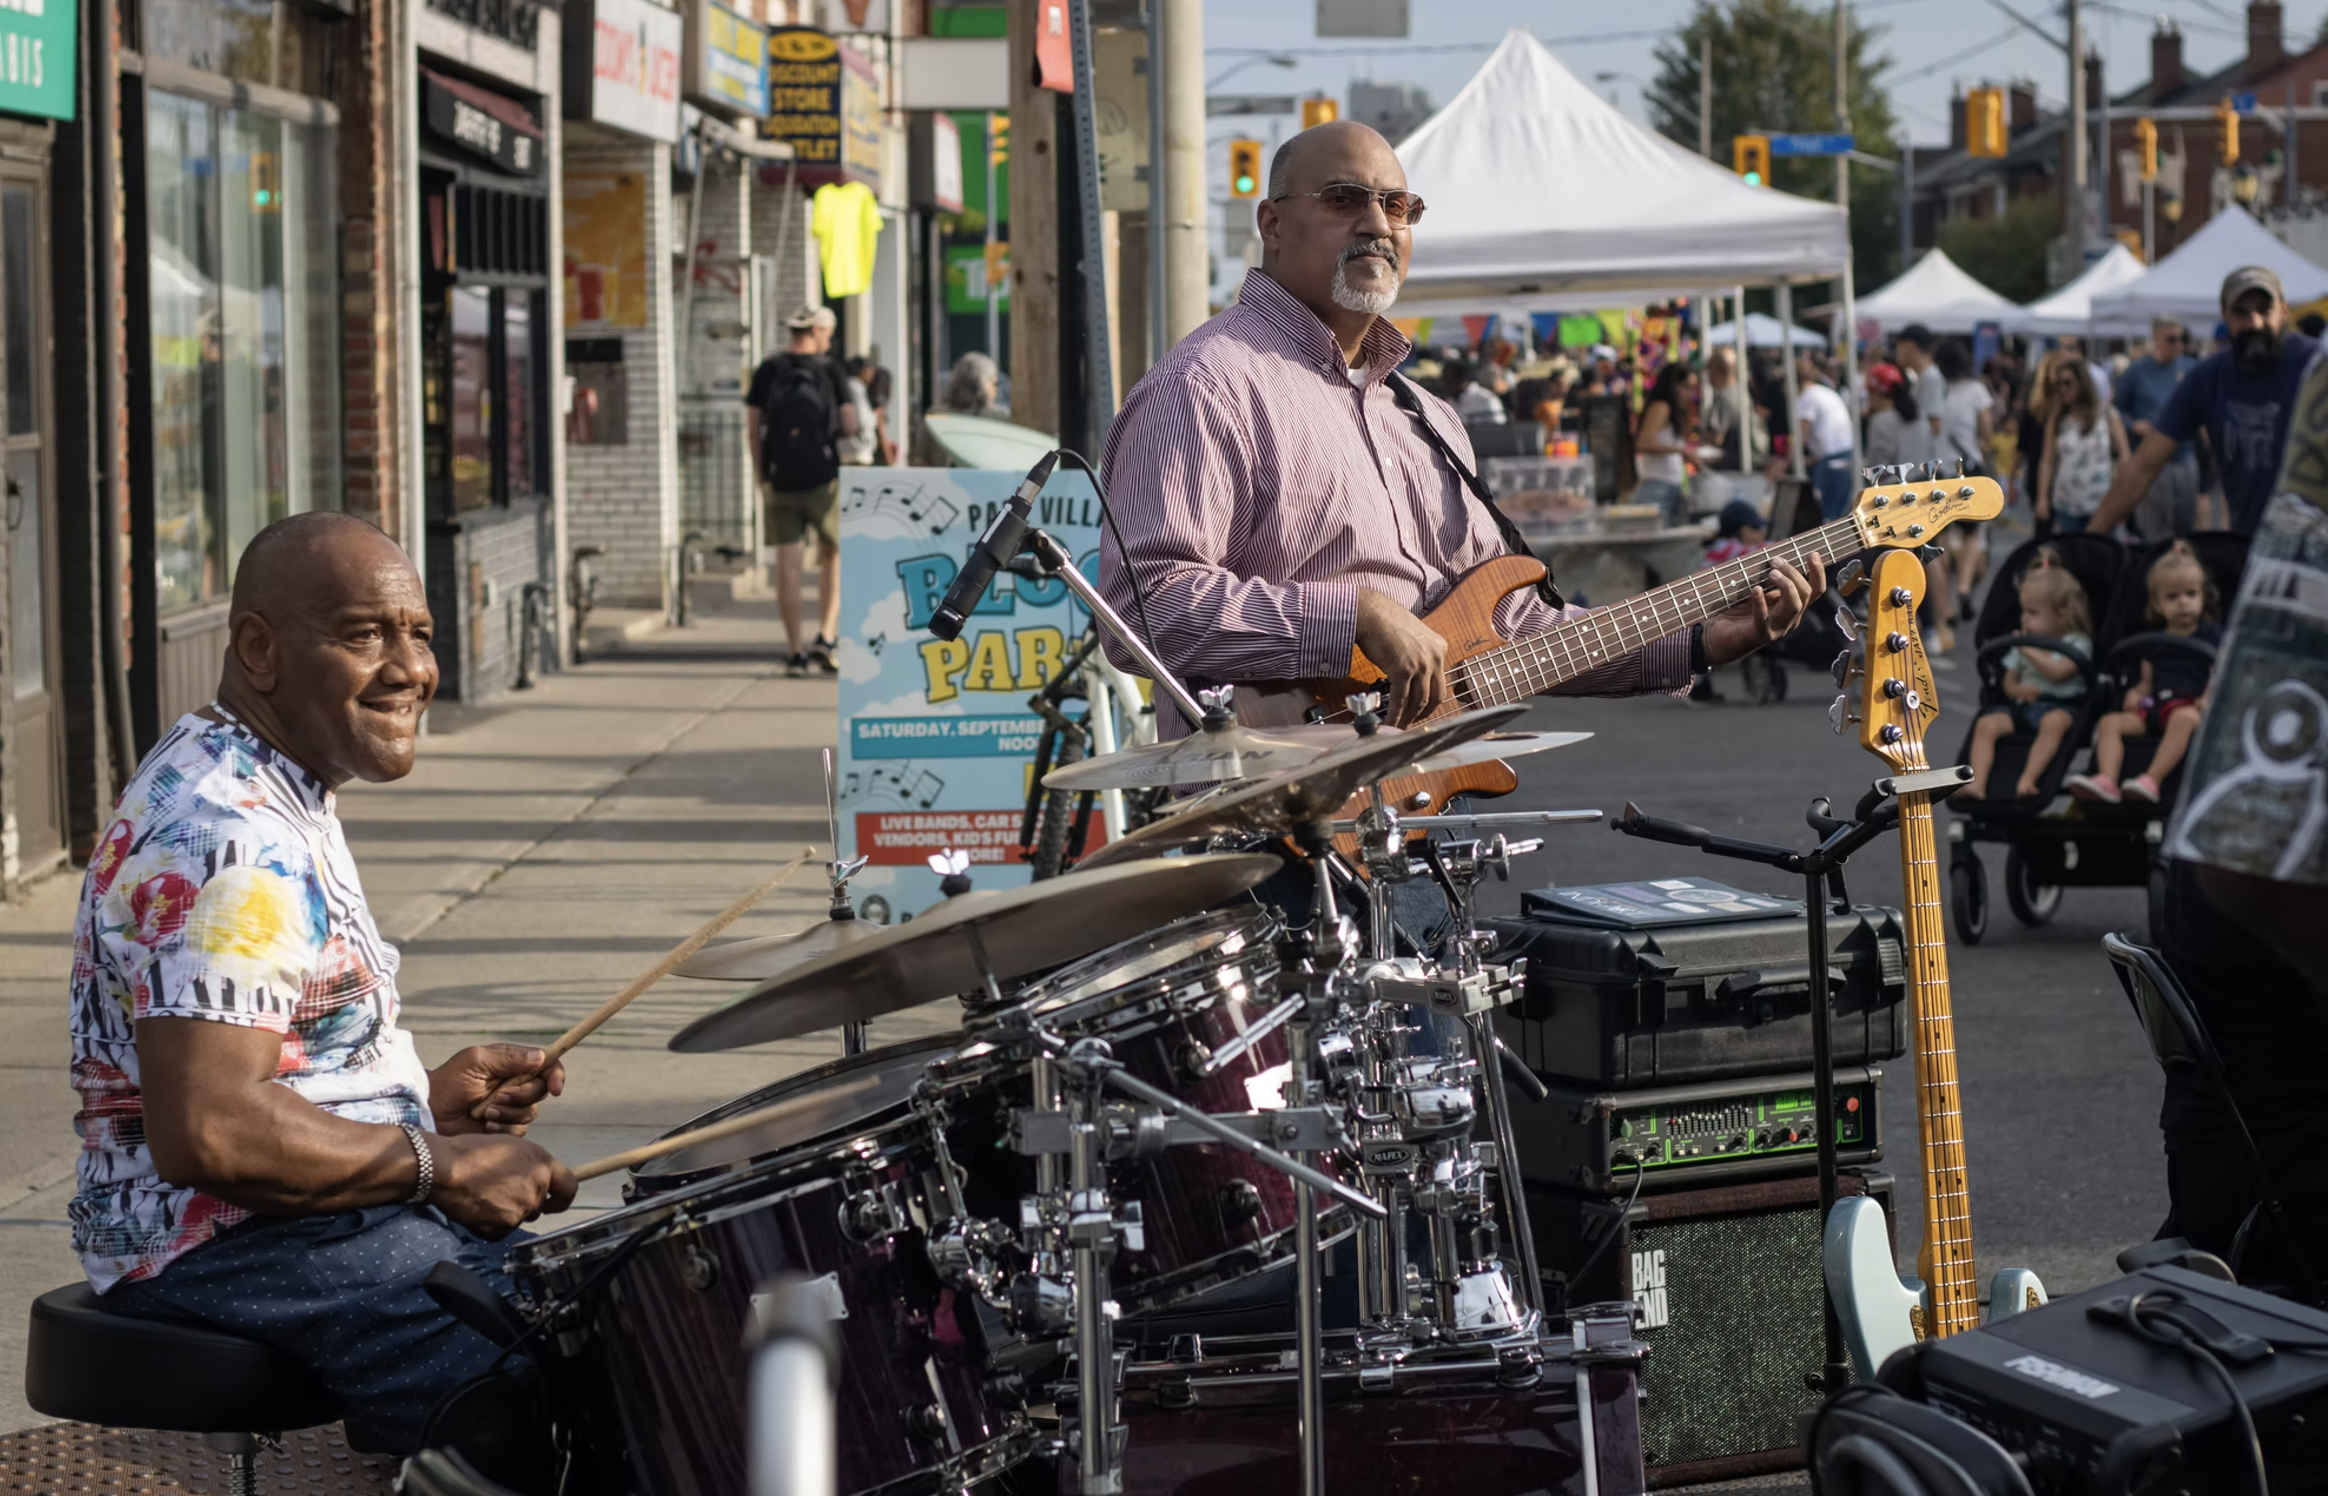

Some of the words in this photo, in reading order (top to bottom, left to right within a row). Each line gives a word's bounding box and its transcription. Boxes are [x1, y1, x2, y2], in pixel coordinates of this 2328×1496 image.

[773, 87, 831, 111] STORE
[792, 138, 837, 160] TLET
[953, 258, 1009, 299] T
[998, 735, 1039, 751] NOO
[880, 815, 912, 831] LIVE
[973, 814, 1010, 830] CAR
[967, 847, 1006, 862] ORE!
[1631, 1248, 1666, 1291] BAG
